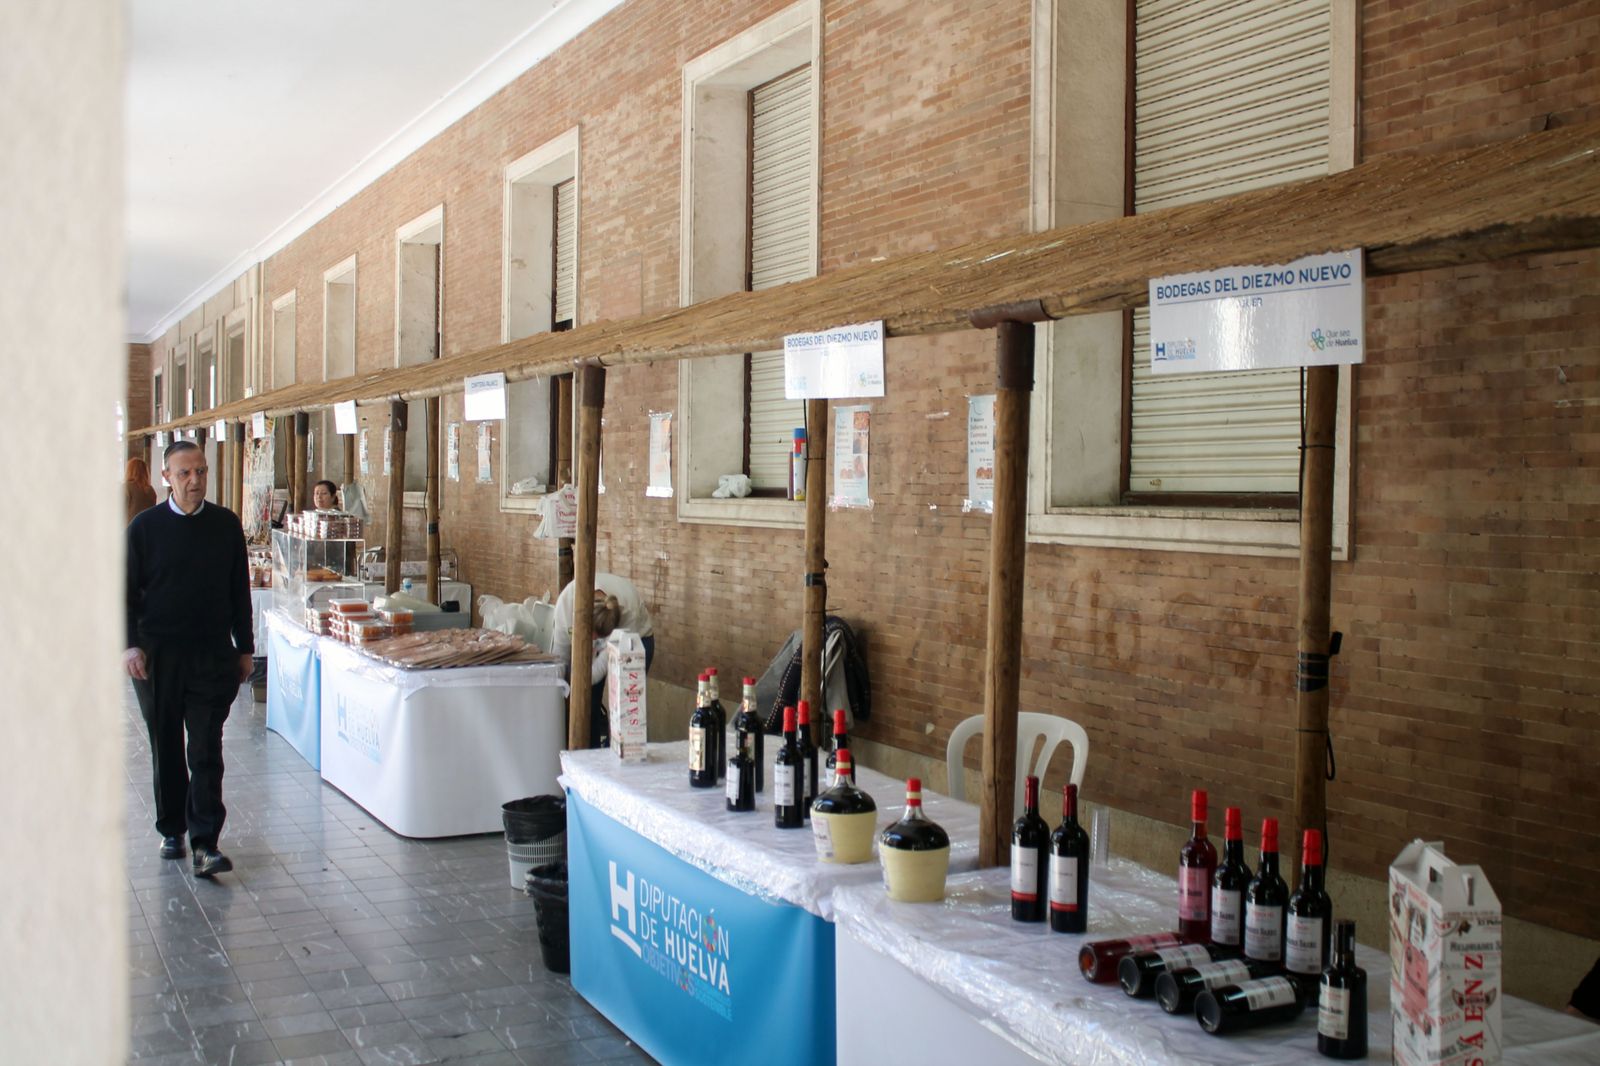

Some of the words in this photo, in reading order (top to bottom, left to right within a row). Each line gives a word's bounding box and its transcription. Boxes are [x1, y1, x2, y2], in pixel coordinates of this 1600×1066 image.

[1156, 280, 1211, 299] BODEGAS
[1214, 277, 1238, 295] DEL
[1241, 270, 1295, 290] DIEZMO
[1299, 263, 1352, 284] NUEVO
[787, 336, 814, 348] BODEGAS
[826, 332, 852, 343] DIEZMO
[853, 329, 879, 342] NUEVO
[1155, 343, 1166, 357] H
[1335, 338, 1358, 347] Huelva
[608, 860, 637, 936] H
[640, 878, 730, 961] DIPUTACIÓN
[640, 911, 659, 949] DE
[664, 926, 730, 996] HUELVA
[642, 942, 696, 997] OBJETIVOS
